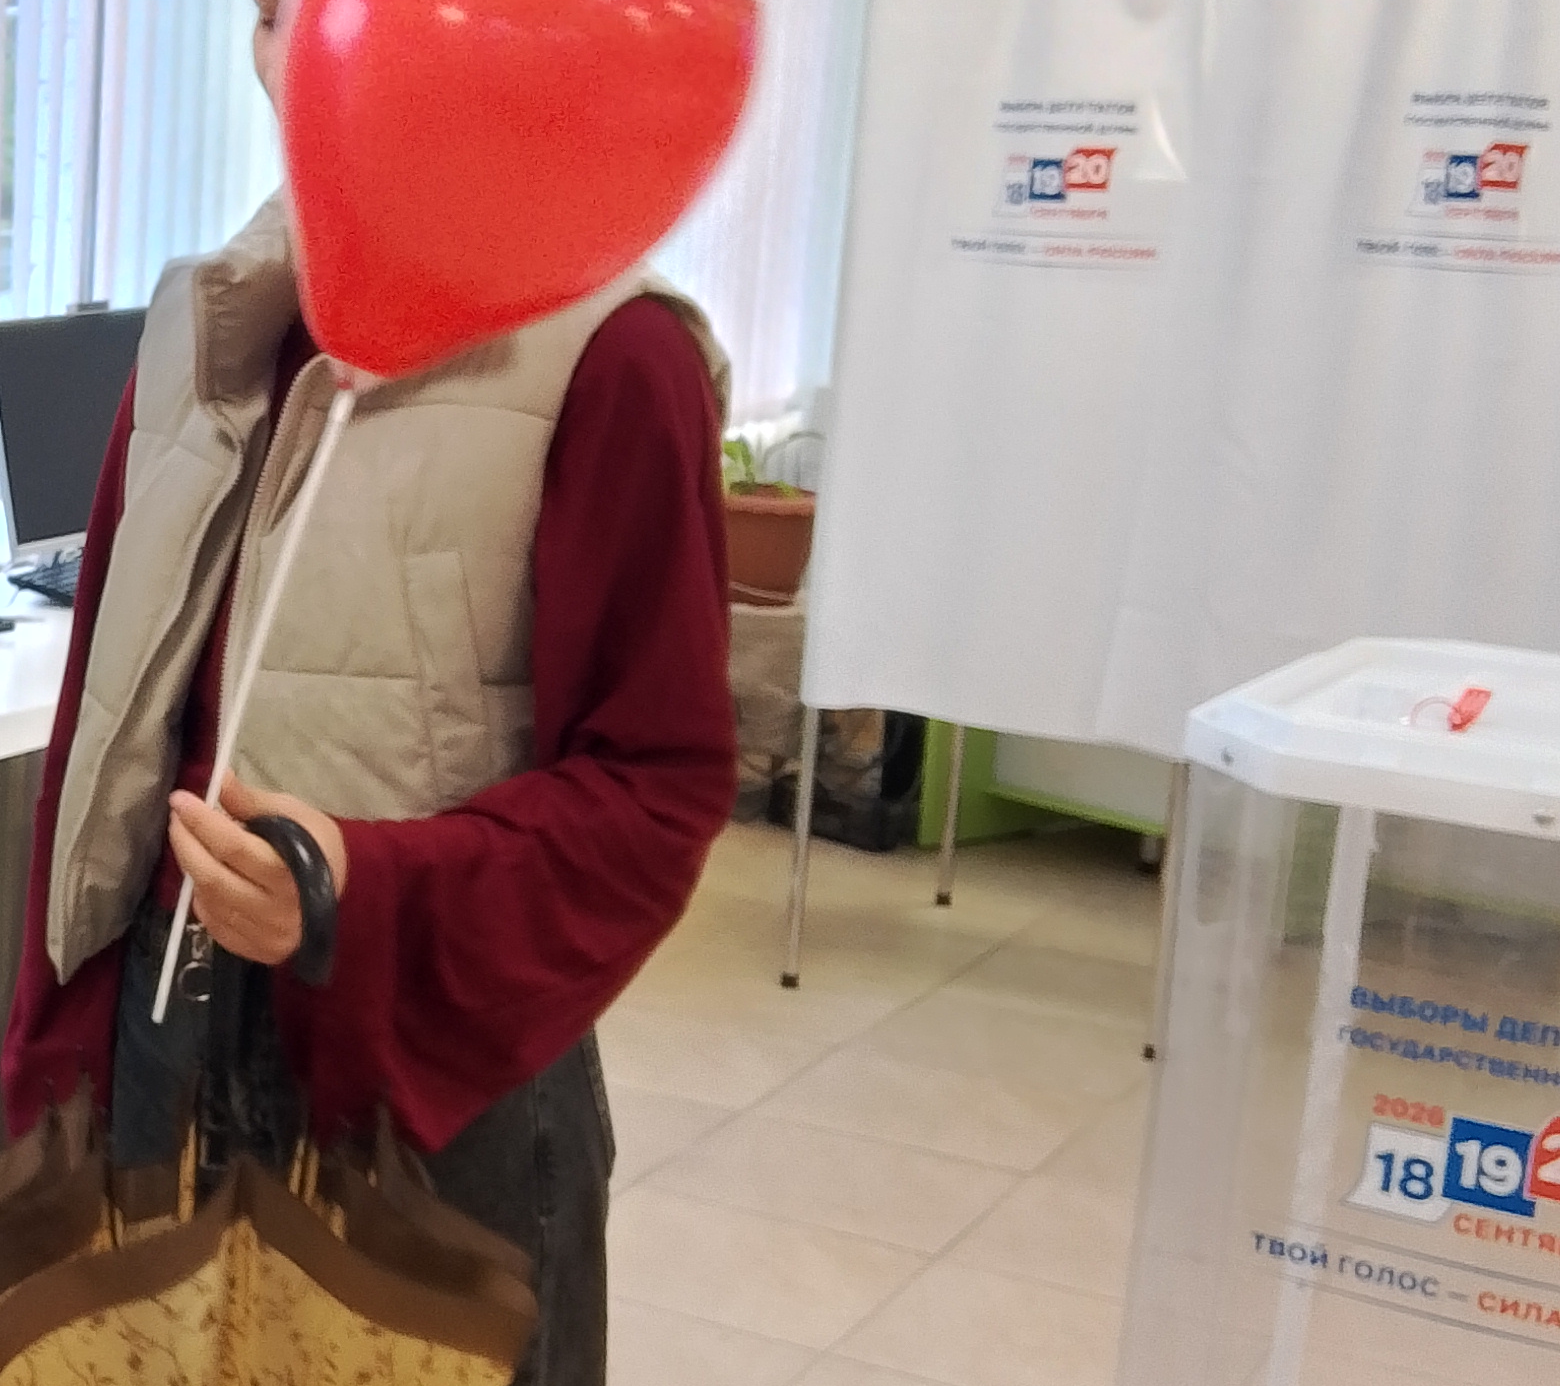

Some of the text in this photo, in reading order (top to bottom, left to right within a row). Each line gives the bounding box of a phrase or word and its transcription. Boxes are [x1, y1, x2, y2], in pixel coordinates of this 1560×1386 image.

[1064, 153, 1107, 184] 20
[1480, 149, 1521, 182] 20
[1350, 985, 1489, 1033] ВЫБОРЫ
[1372, 1092, 1446, 1129] 2026
[1374, 1148, 1435, 1201] 18
[1454, 1138, 1523, 1197] 19
[1452, 1212, 1560, 1255] СЕНТЯ
[1252, 1229, 1329, 1269] ТВОЙ
[1338, 1255, 1441, 1298] ГОЛОС
